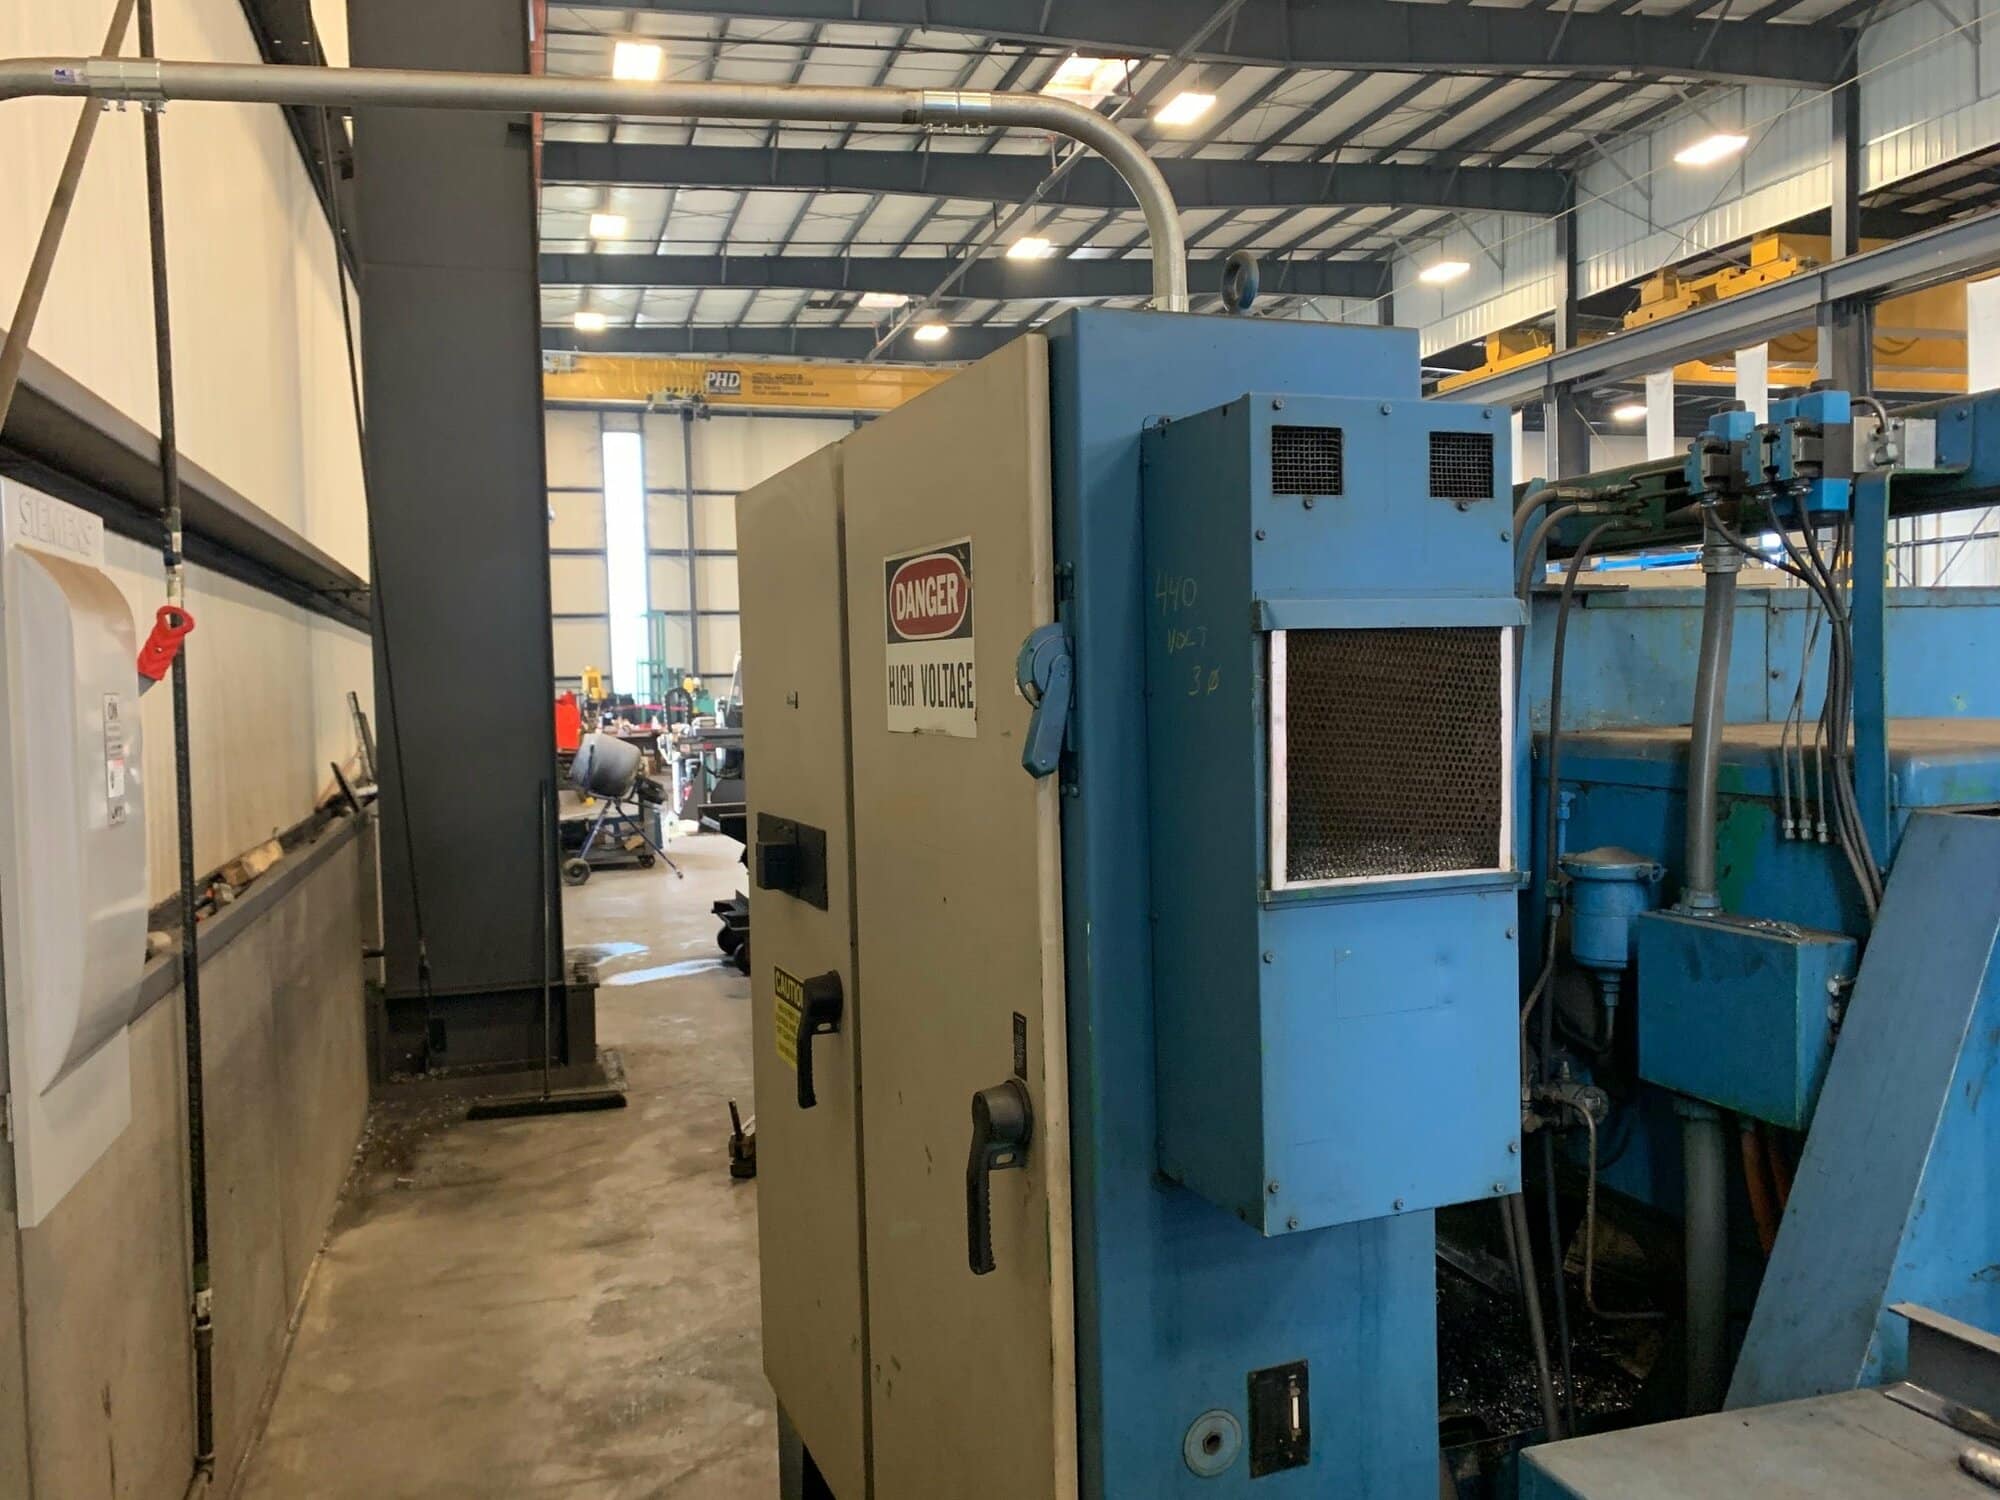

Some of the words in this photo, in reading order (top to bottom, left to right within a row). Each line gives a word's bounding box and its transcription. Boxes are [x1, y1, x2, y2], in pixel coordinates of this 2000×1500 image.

[706, 371, 740, 387] PHD
[19, 497, 96, 556] SIEMENS
[896, 572, 959, 620] DANGER
[1155, 570, 1197, 616] 440
[888, 664, 914, 706] HIGH
[920, 662, 974, 708] VOLTAGE
